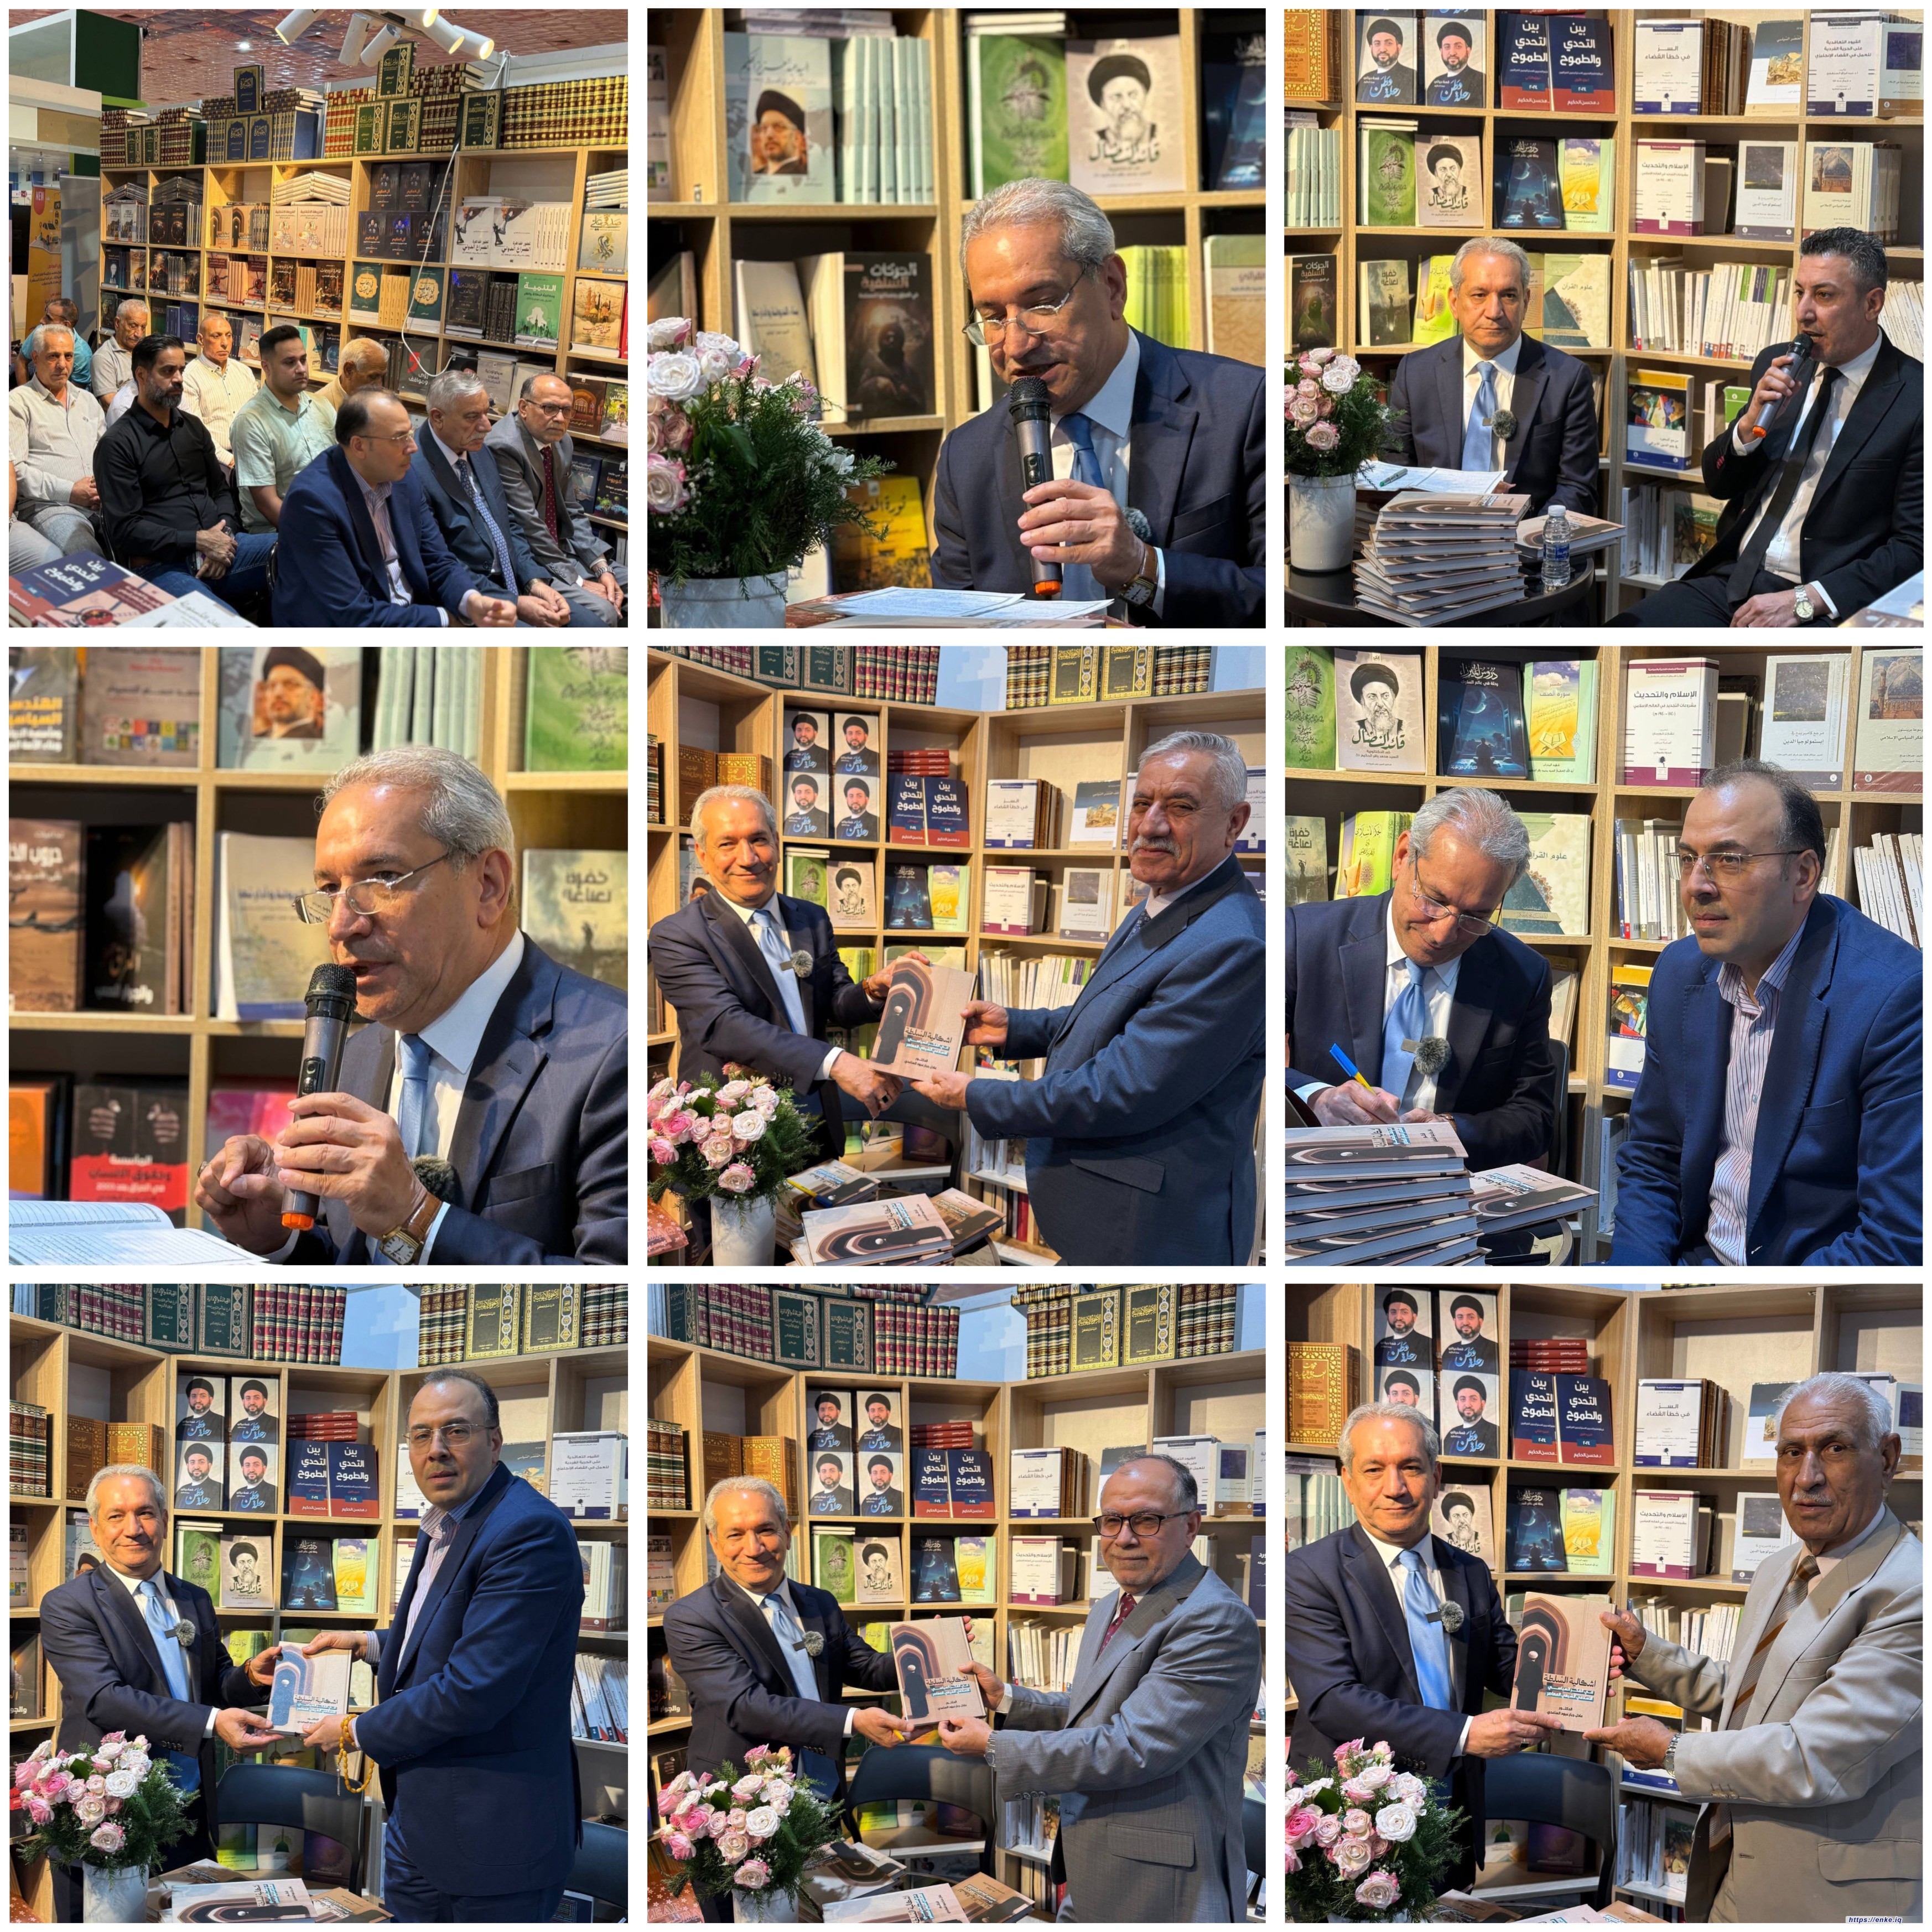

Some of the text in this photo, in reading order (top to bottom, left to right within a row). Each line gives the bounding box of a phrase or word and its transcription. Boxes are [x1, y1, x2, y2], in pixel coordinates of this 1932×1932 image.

[1522, 20, 1539, 33] بين
[1570, 23, 1586, 35] بين
[1563, 39, 1595, 51] التحدي
[1560, 54, 1601, 67] والطموح
[35, 191, 44, 200] NEW
[870, 262, 917, 277] الحركات
[1306, 261, 1329, 269] الحركات
[524, 282, 556, 291] التنمية
[1562, 282, 1577, 291] القرآن
[1352, 729, 1405, 750] قائد النضال
[905, 779, 917, 788] بين
[939, 782, 951, 791] بين
[932, 804, 960, 814] والطموح
[928, 1032, 952, 1043] اشكالية
[1531, 1377, 1546, 1390] بين
[1575, 1381, 1589, 1394] بين
[1569, 1397, 1597, 1408] التحدي
[1566, 1410, 1602, 1423] والطموح
[307, 1444, 321, 1456] بين
[344, 1445, 357, 1456] بين
[928, 1453, 941, 1461] بين
[962, 1454, 974, 1463] بين
[339, 1460, 364, 1470] التحدي
[958, 1466, 980, 1474] التحدي
[336, 1472, 369, 1482] والطموح
[955, 1476, 985, 1486] والطموح
[1640, 1510, 1666, 1519] والتحديث
[1570, 1677, 1596, 1687] اشكالية
